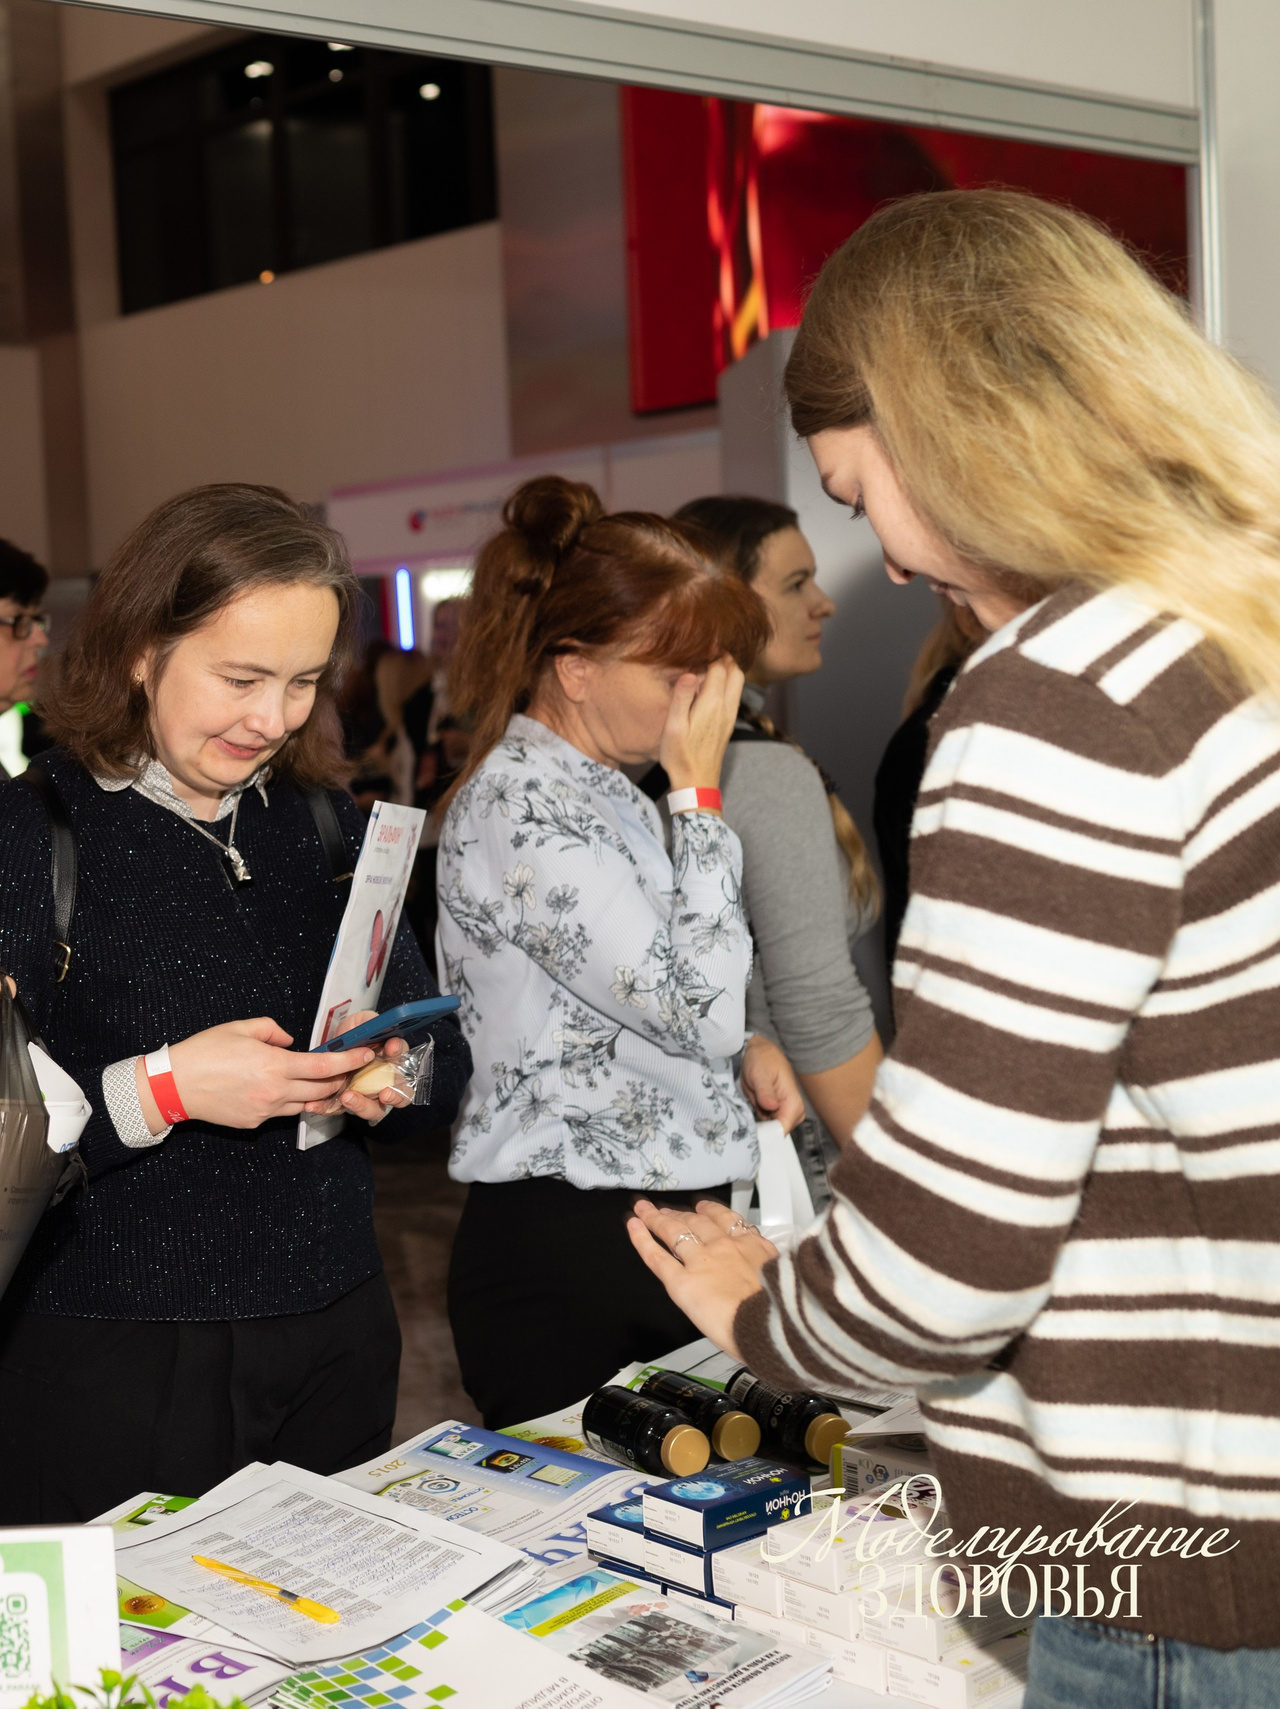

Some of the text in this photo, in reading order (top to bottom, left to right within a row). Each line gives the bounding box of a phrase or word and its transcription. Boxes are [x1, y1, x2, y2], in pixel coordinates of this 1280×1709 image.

[367, 1457, 407, 1478] 2015
[743, 1467, 789, 1485] НОЧНОЙ
[765, 1489, 806, 1515] НОЧНОЙ
